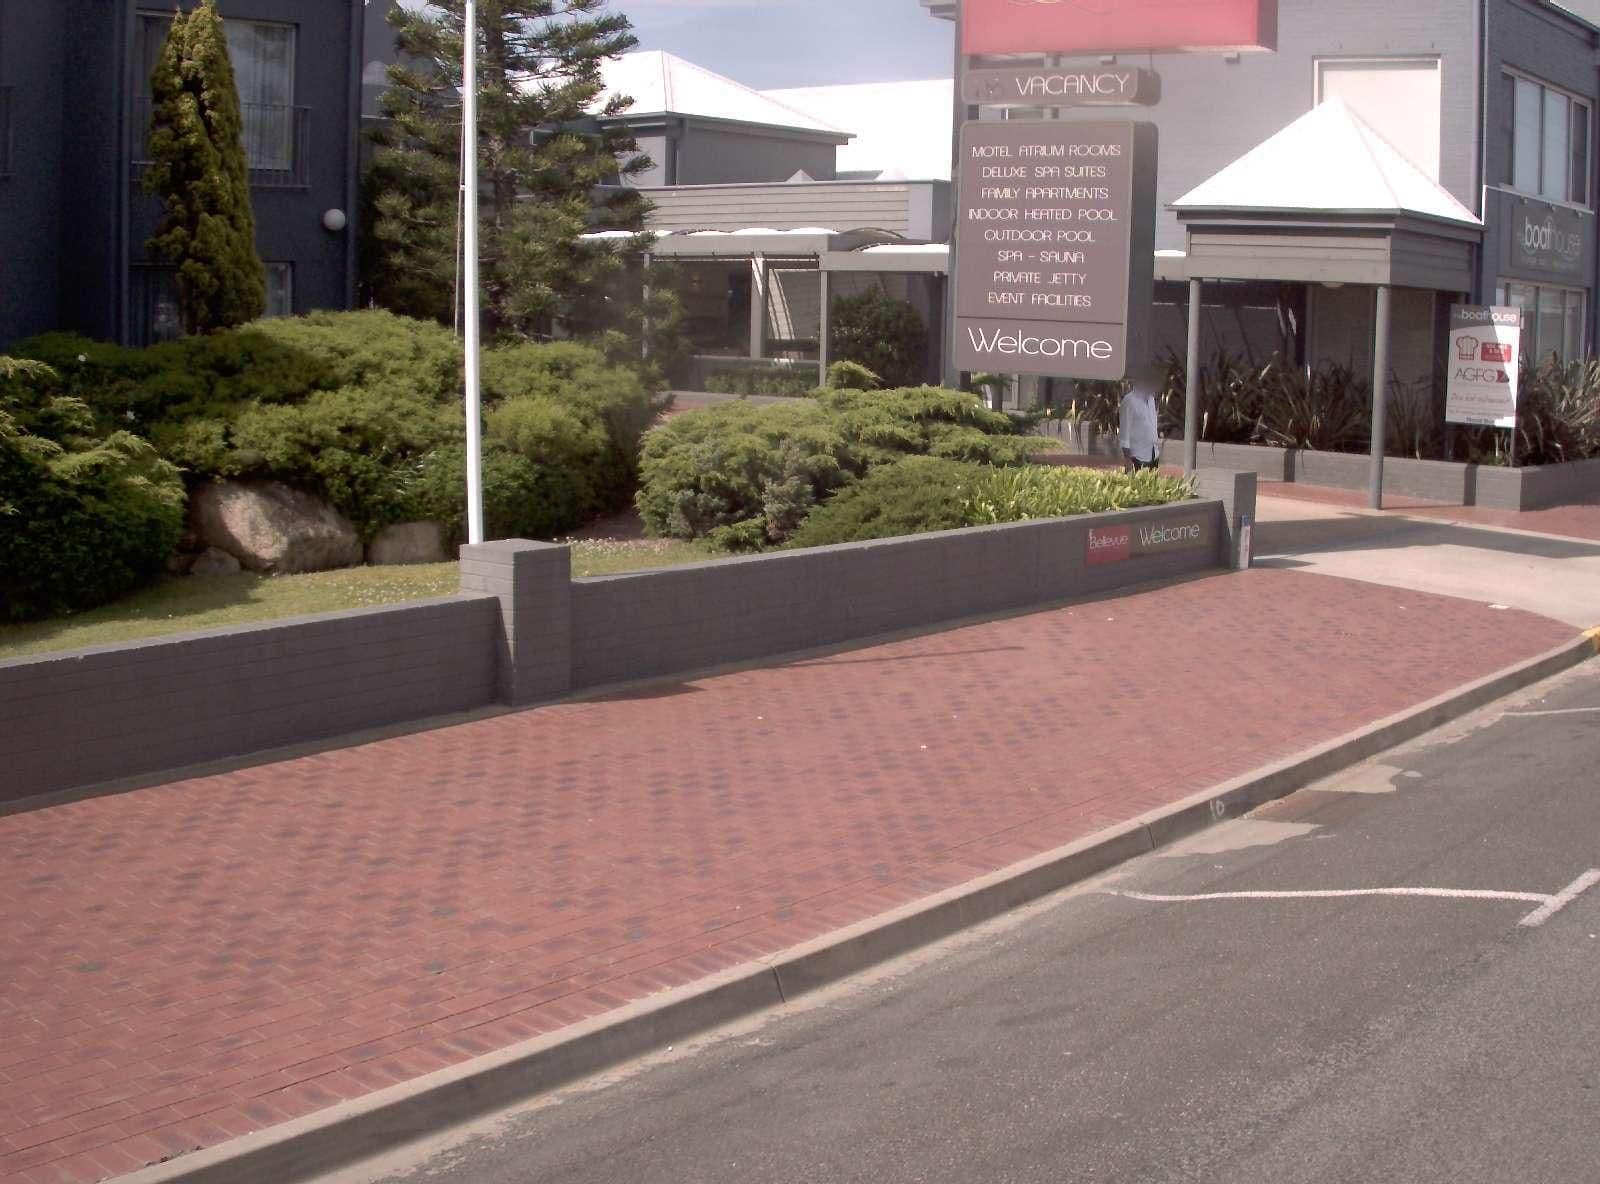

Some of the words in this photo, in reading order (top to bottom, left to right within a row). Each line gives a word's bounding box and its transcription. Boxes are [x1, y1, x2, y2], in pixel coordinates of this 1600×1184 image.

[1015, 73, 1132, 96] VACANCY
[972, 146, 1014, 158] MOTEL
[1018, 145, 1065, 157] ATRIUM
[1069, 144, 1121, 156] ROOMS
[982, 166, 1027, 178] DELUXE
[1034, 166, 1060, 178] SPA
[1064, 165, 1106, 178] SUITES
[981, 187, 1020, 199] FAMILY
[1025, 187, 1109, 199] APARTMENTS
[968, 208, 1019, 221] INDOOR
[1024, 208, 1072, 221] HEATED
[1078, 208, 1118, 221] POOL
[984, 229, 1052, 242] OUTDOOR
[1057, 230, 1096, 243] POOL
[997, 250, 1023, 263] SPA
[1039, 251, 1085, 264] SAUNA
[993, 270, 1041, 284] PRIVATE
[1047, 272, 1087, 285] JETTY
[988, 291, 1025, 305] EVENT
[1031, 293, 1092, 307] FACILITIES
[967, 326, 1113, 359] Welcome
[1139, 523, 1200, 547] Welcome
